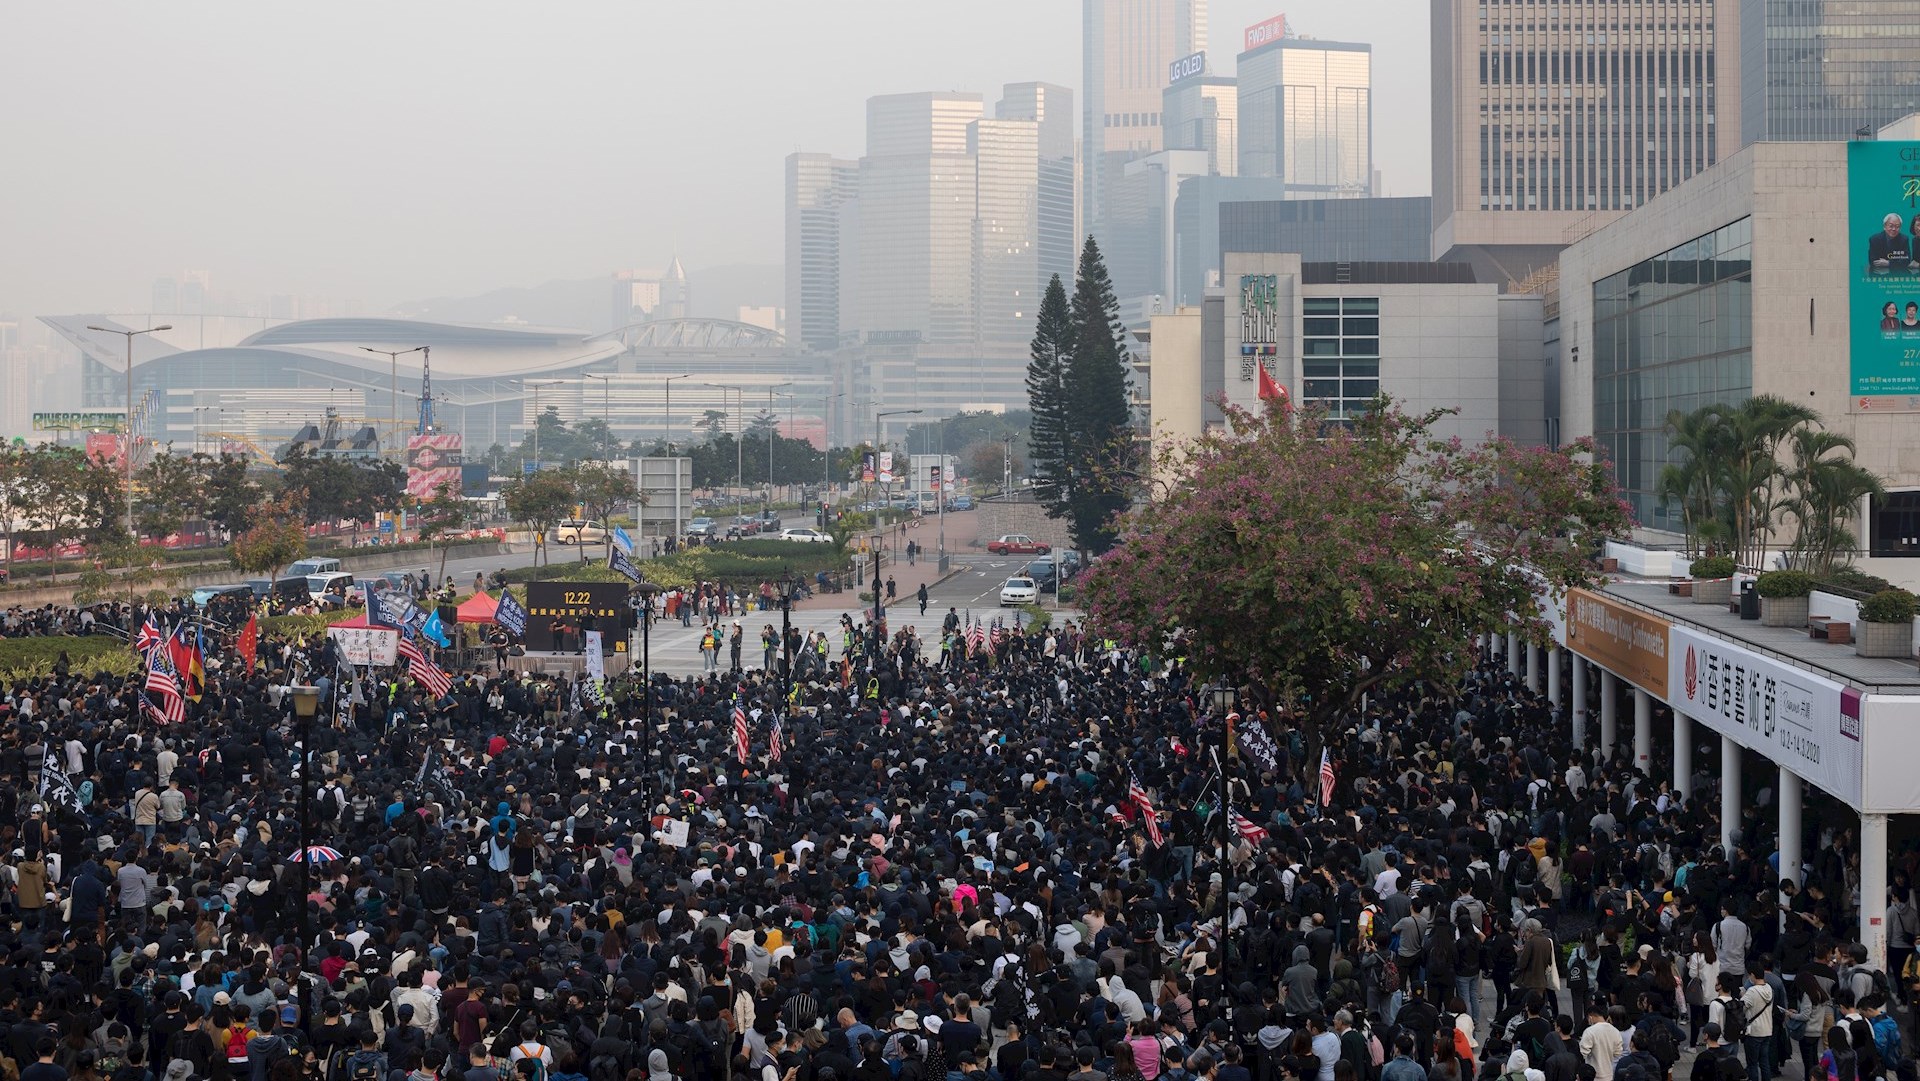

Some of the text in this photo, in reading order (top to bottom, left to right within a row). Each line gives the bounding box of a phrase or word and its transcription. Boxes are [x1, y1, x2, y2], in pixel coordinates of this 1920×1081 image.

[1248, 26, 1265, 47] FWD
[1170, 55, 1202, 82] LG OLED
[564, 591, 591, 605] 12.22
[1605, 610, 1618, 644] Hong
[1618, 615, 1633, 651] Kong
[1633, 620, 1665, 658] Sinfonietta
